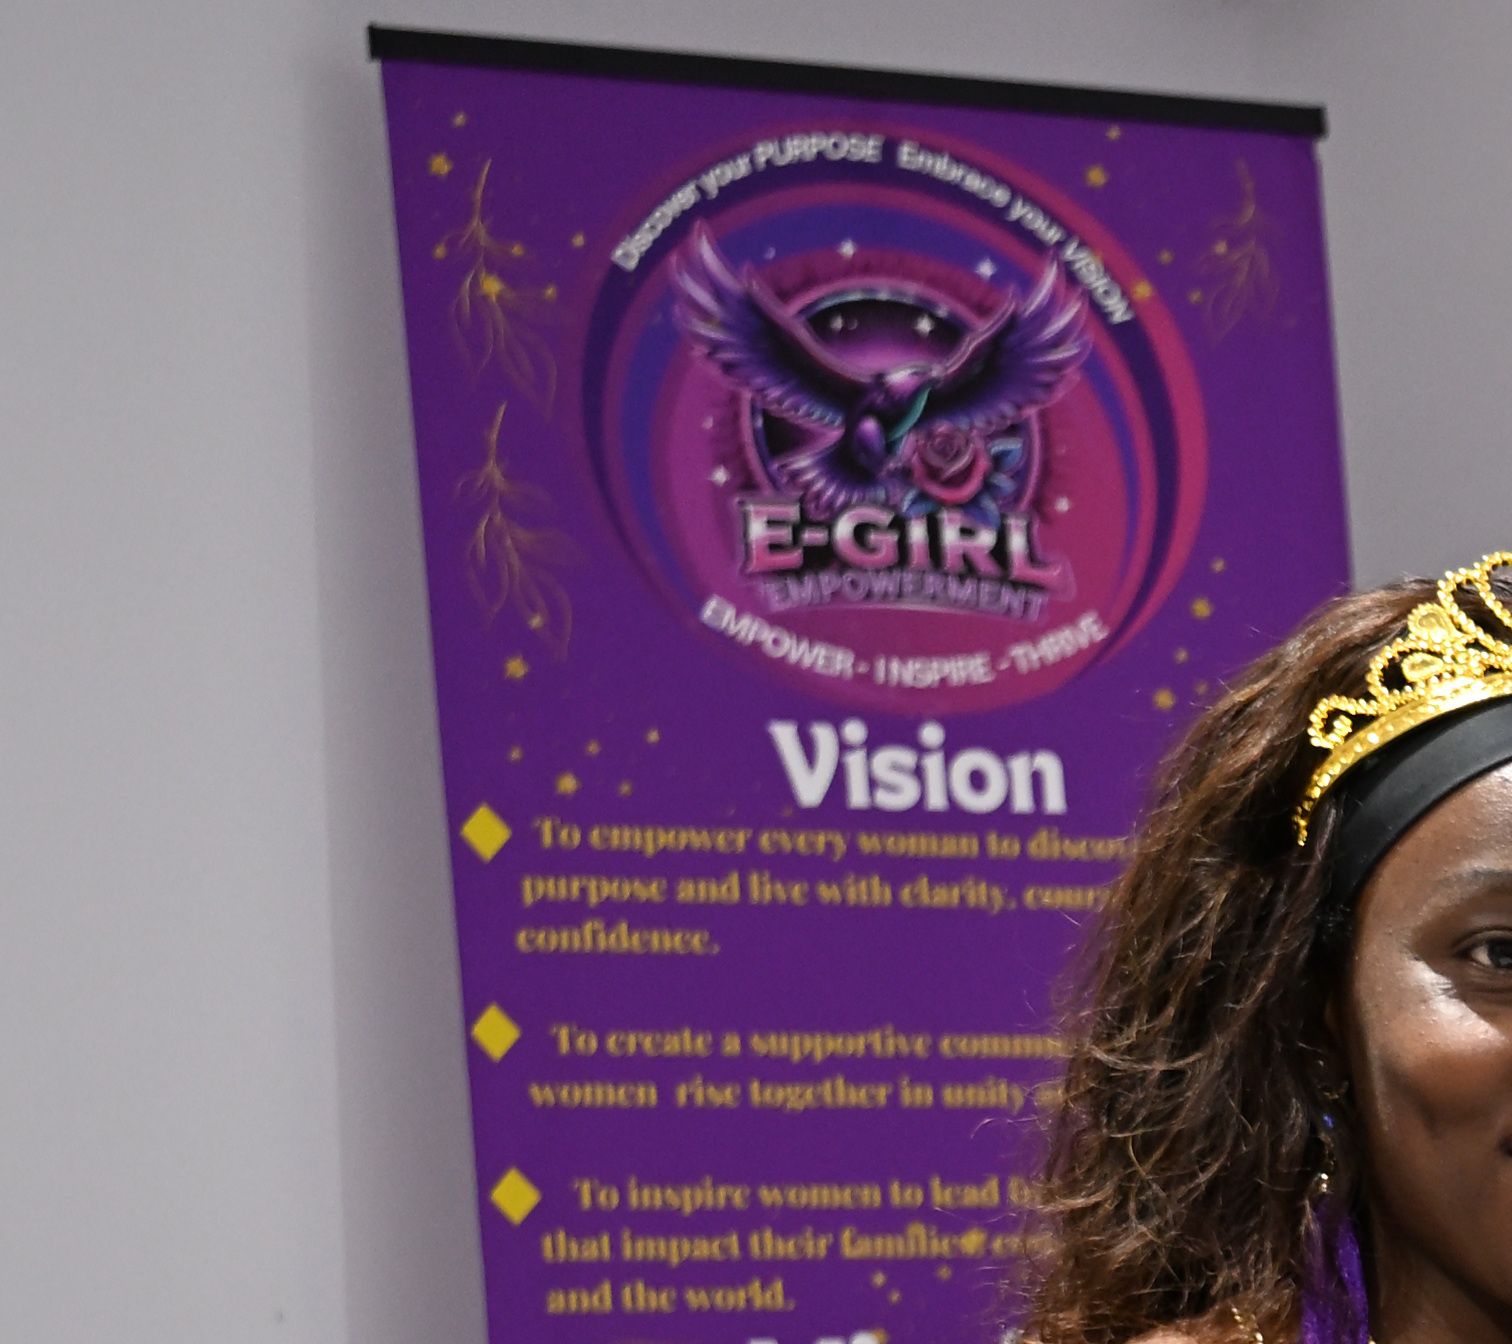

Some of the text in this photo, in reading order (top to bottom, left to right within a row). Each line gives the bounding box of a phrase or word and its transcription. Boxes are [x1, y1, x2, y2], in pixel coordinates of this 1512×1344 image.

[610, 180, 701, 272] Discover
[752, 131, 886, 172] PURPOSE
[897, 140, 1012, 208] Embrace
[1005, 195, 1066, 246] your
[1062, 235, 1135, 325] VISION
[762, 568, 1052, 622] EMPOWERMENT
[702, 594, 855, 681] EMPOWER
[1008, 610, 1110, 676] THRIVE
[767, 718, 1067, 815] Vision
[533, 816, 582, 848] To
[589, 824, 752, 858] empower
[758, 828, 846, 862] every
[858, 831, 979, 858] woman
[986, 829, 1021, 859] to
[522, 874, 667, 908] purpose
[676, 869, 740, 904] and
[749, 868, 808, 905] live
[817, 871, 892, 908] with
[515, 918, 720, 955] confidence.
[551, 1022, 598, 1056] To
[605, 1026, 712, 1058] create
[721, 1030, 741, 1057] a
[750, 1024, 932, 1065] supportive
[528, 1081, 658, 1108] women
[676, 1072, 741, 1108] rise
[750, 1074, 892, 1114] together
[901, 1075, 934, 1108] in
[942, 1075, 1024, 1115] unity
[574, 1177, 620, 1211] To
[628, 1174, 749, 1217] inspire
[758, 1184, 881, 1210] women
[889, 1178, 924, 1209] to
[930, 1174, 998, 1209] lead
[541, 1228, 610, 1264] that
[621, 1226, 740, 1269] impact
[749, 1225, 833, 1260] their
[546, 1277, 613, 1315] and
[621, 1277, 677, 1314] the
